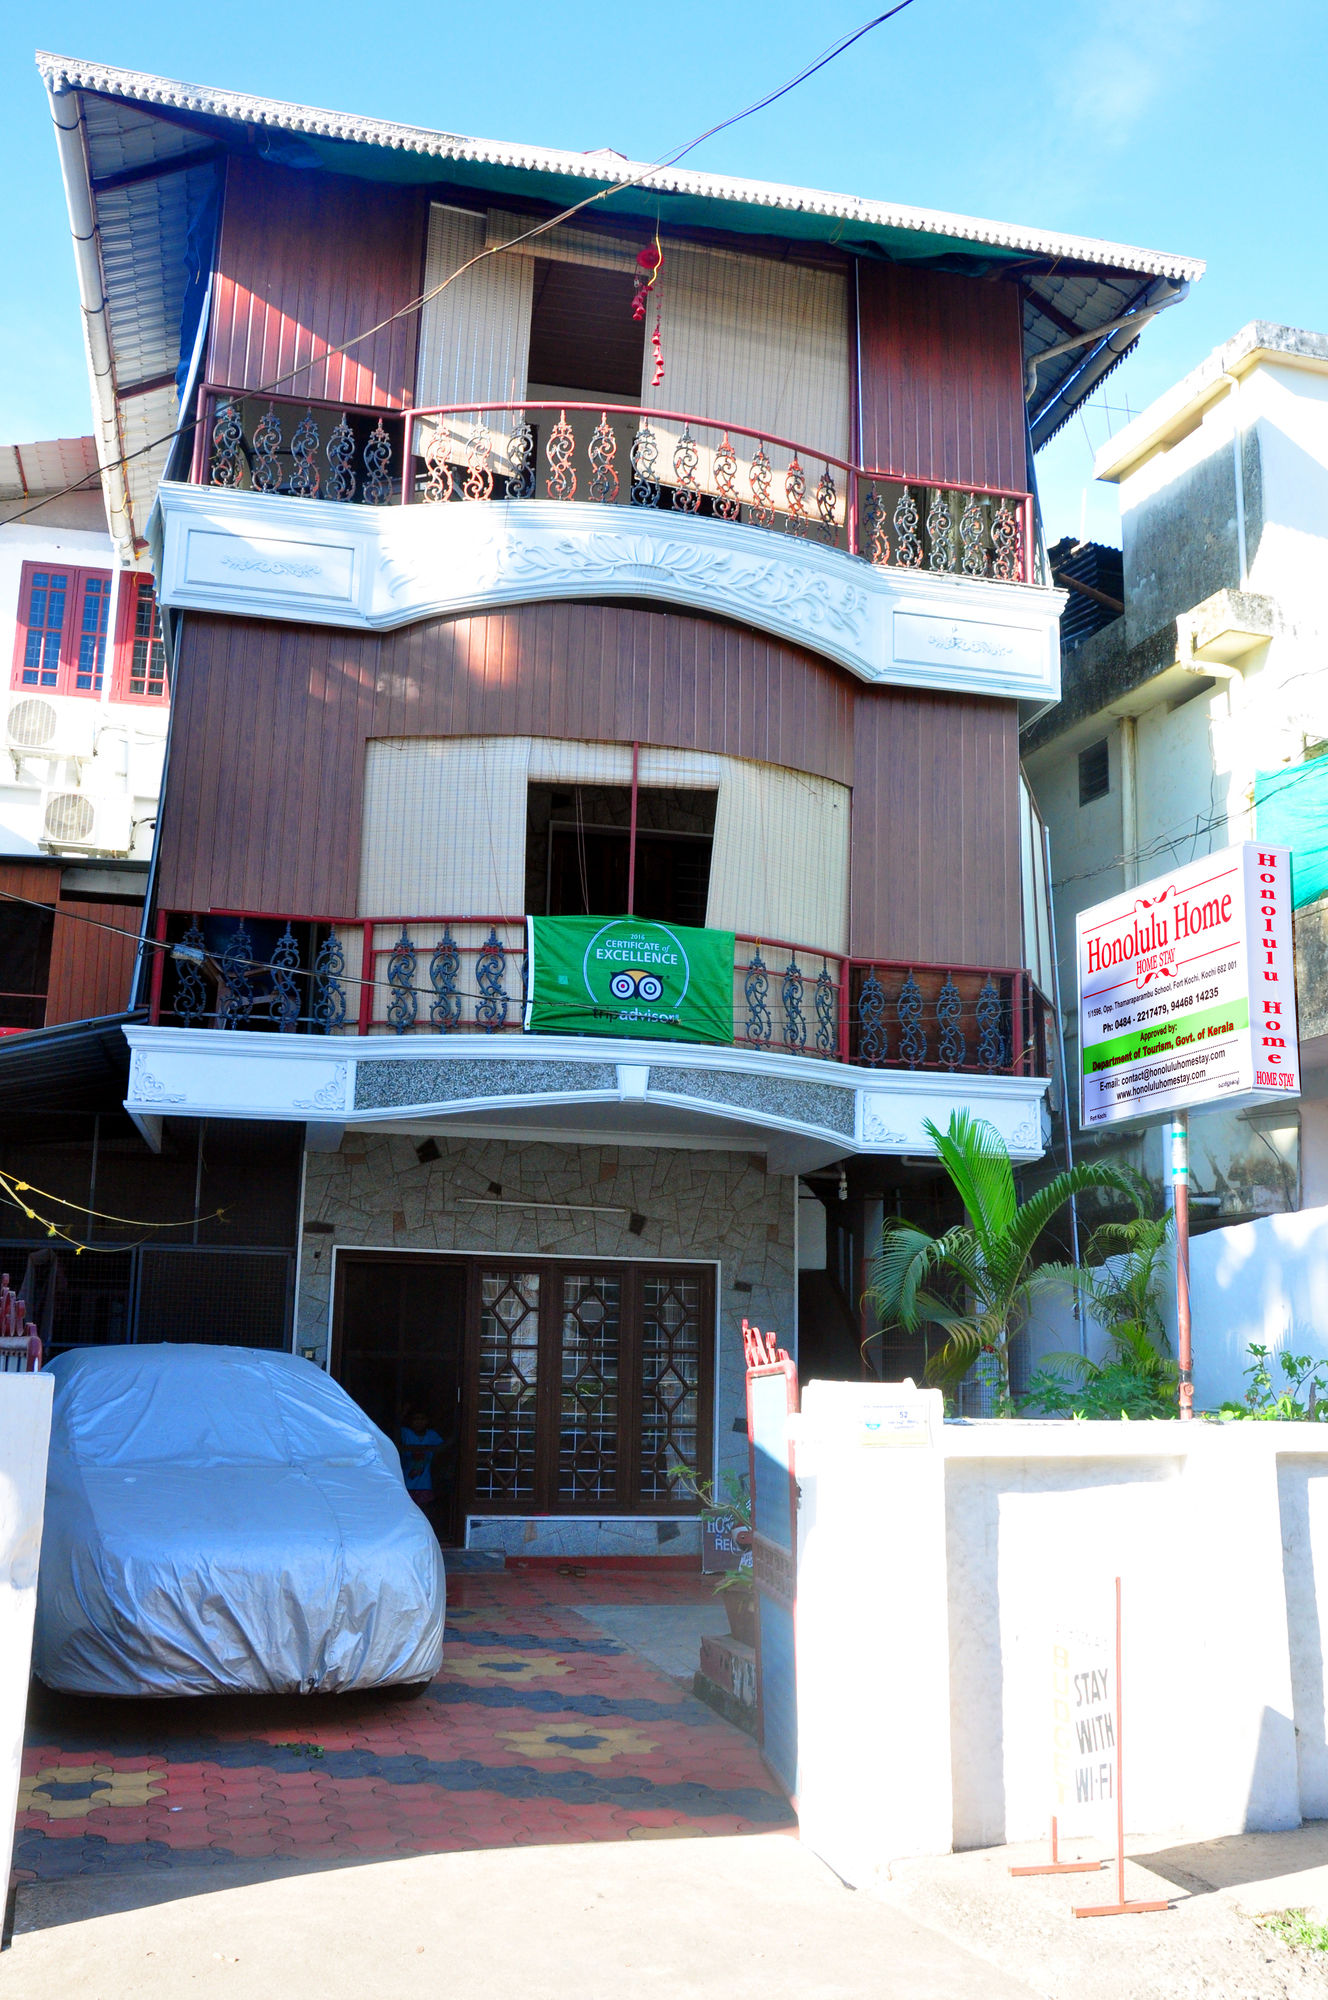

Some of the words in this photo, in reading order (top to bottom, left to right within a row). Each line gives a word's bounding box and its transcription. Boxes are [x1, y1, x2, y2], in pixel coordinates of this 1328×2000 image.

[630, 933, 646, 941] 2016
[1087, 912, 1168, 974] Honolulu
[1174, 893, 1233, 941] Home
[1257, 853, 1279, 982] Honolulu
[596, 949, 678, 965] EXCELLENCE
[605, 939, 660, 951] CERTIFICATE
[661, 944, 670, 953] of
[1136, 954, 1158, 976] HOME
[1158, 948, 1176, 969] STAY
[1103, 1004, 1114, 1014] Opp.
[1114, 991, 1154, 1010] Thamaraparambu
[1154, 984, 1172, 997] School,
[1173, 979, 1184, 989] Fort
[1184, 974, 1200, 985] Kochi,
[1201, 968, 1217, 979] Kochi
[1217, 964, 1227, 975] 682
[1227, 960, 1237, 971] 001
[1102, 1022, 1113, 1033] Ph:
[1114, 1016, 1132, 1030] 0484
[1136, 1004, 1169, 1023] 2217479,
[1170, 998, 1194, 1012] 94468
[1195, 987, 1219, 1003] 14235
[1092, 1050, 1132, 1072] Department
[1133, 1047, 1141, 1060] of
[1142, 1040, 1174, 1056] Tourism,
[1175, 1034, 1195, 1047] Govt.
[1197, 1030, 1206, 1041] of
[1207, 1021, 1234, 1037] Kerala
[1140, 1026, 1167, 1042] Approved
[1167, 1023, 1178, 1034] by:
[1261, 1001, 1287, 1065] Home
[1099, 1078, 1121, 1091] E-mail:
[1121, 1049, 1226, 1085] contact@honoluluhomestay.com
[1116, 1068, 1206, 1100] www.honoluluhomestay.com
[1256, 1070, 1278, 1086] HOME
[1278, 1073, 1295, 1088] STAY
[1073, 1667, 1108, 1707] STAY
[1075, 1712, 1115, 1755] WITH
